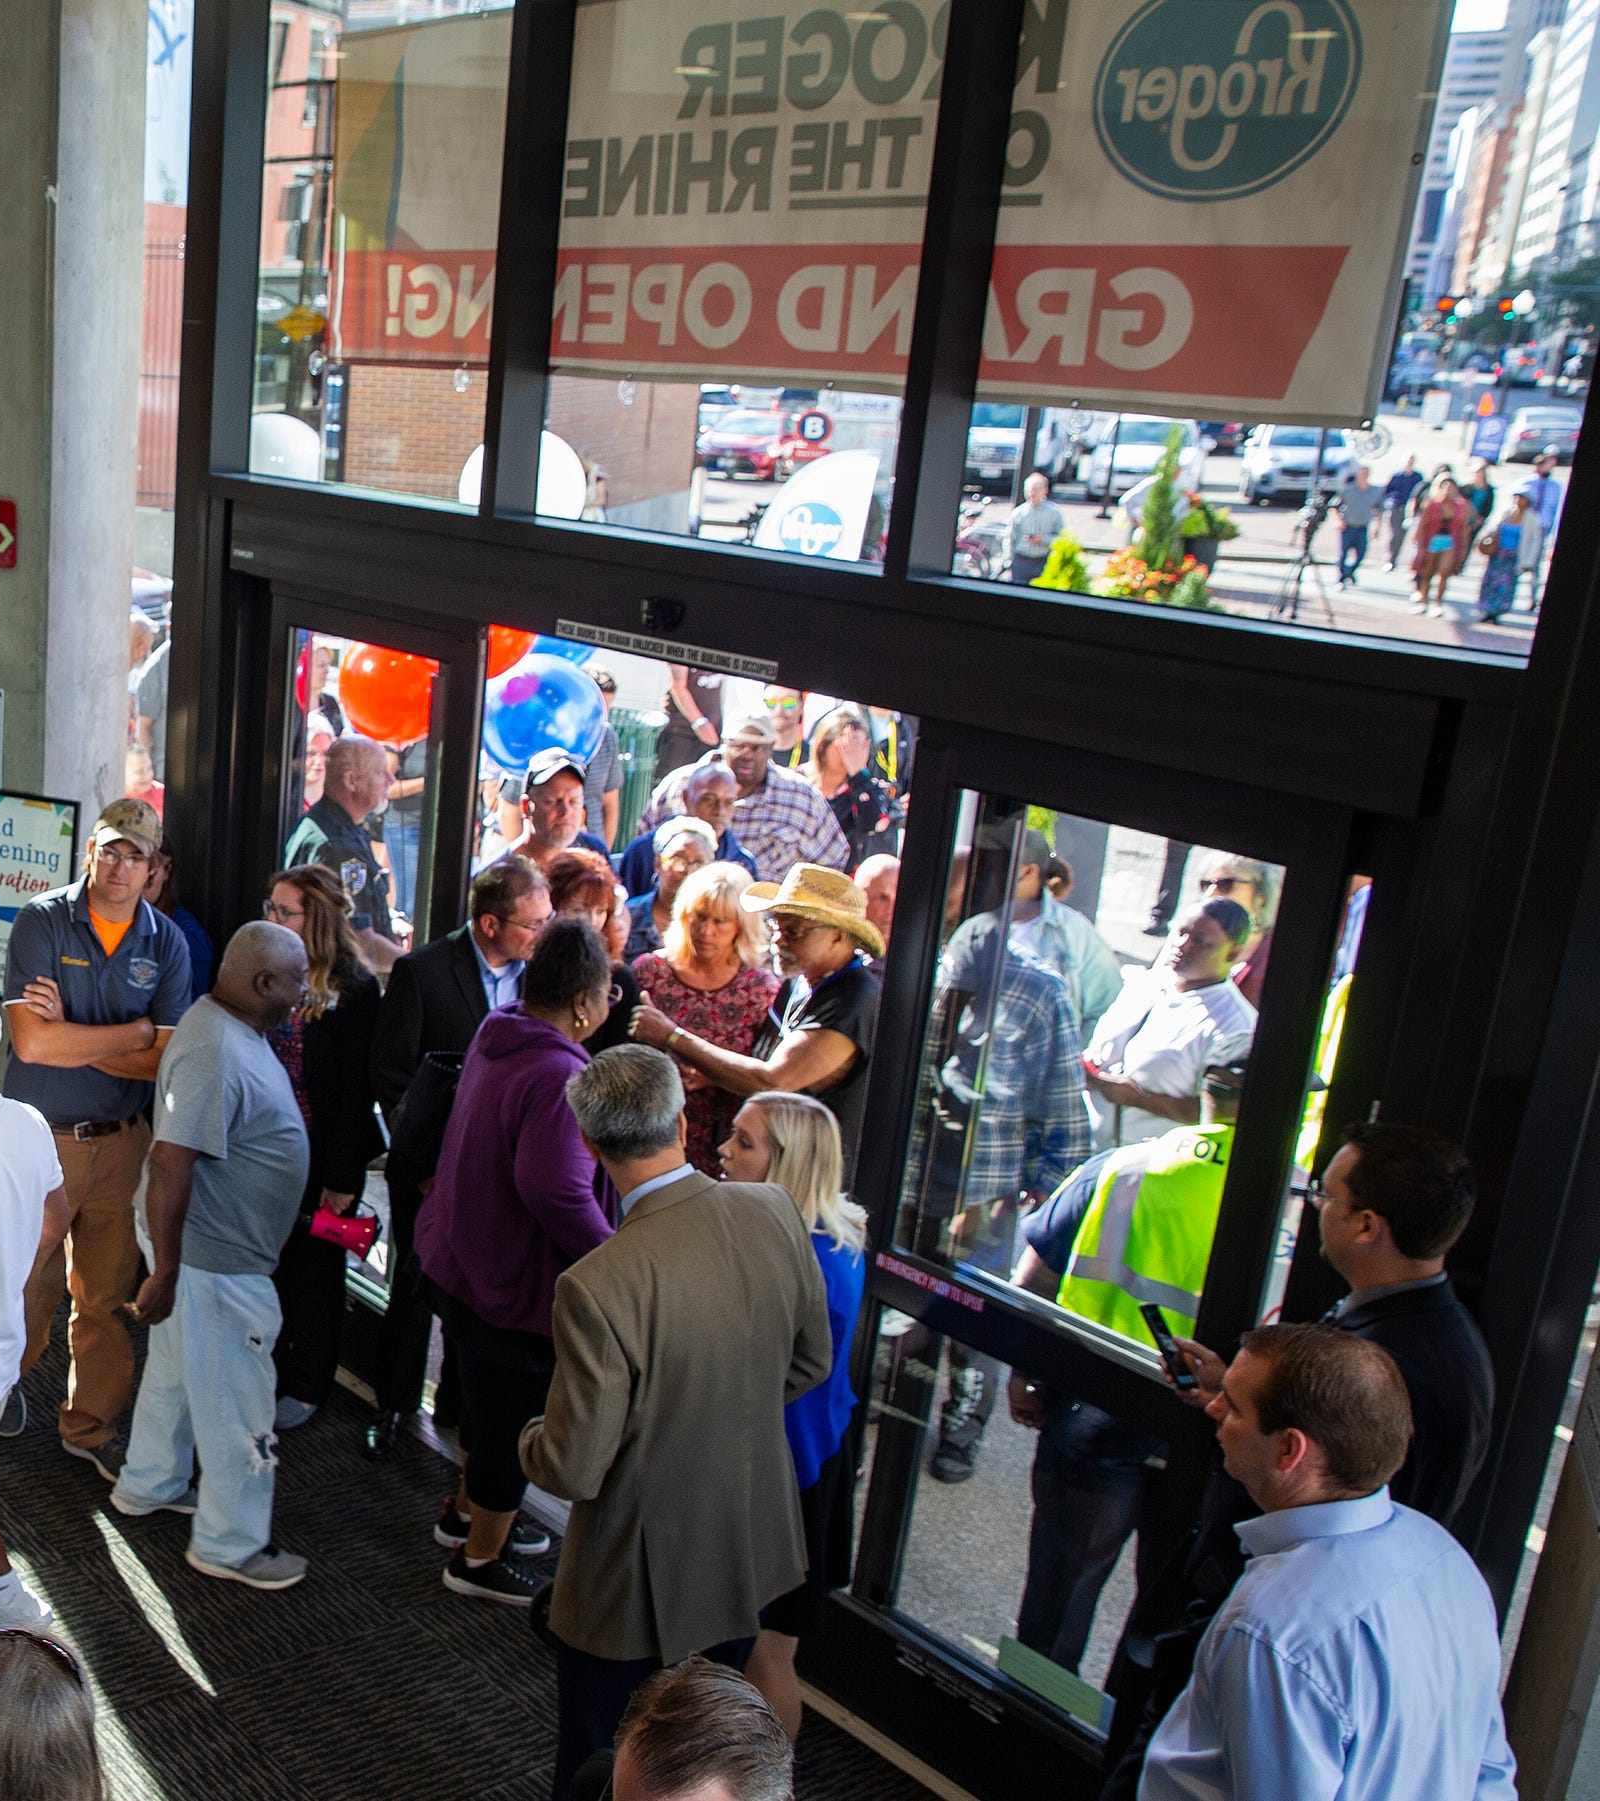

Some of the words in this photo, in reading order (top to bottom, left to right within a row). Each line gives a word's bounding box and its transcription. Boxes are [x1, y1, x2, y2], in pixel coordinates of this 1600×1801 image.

[805, 417, 824, 437] B
[667, 643, 684, 657] WHEN
[686, 647, 698, 660] THE
